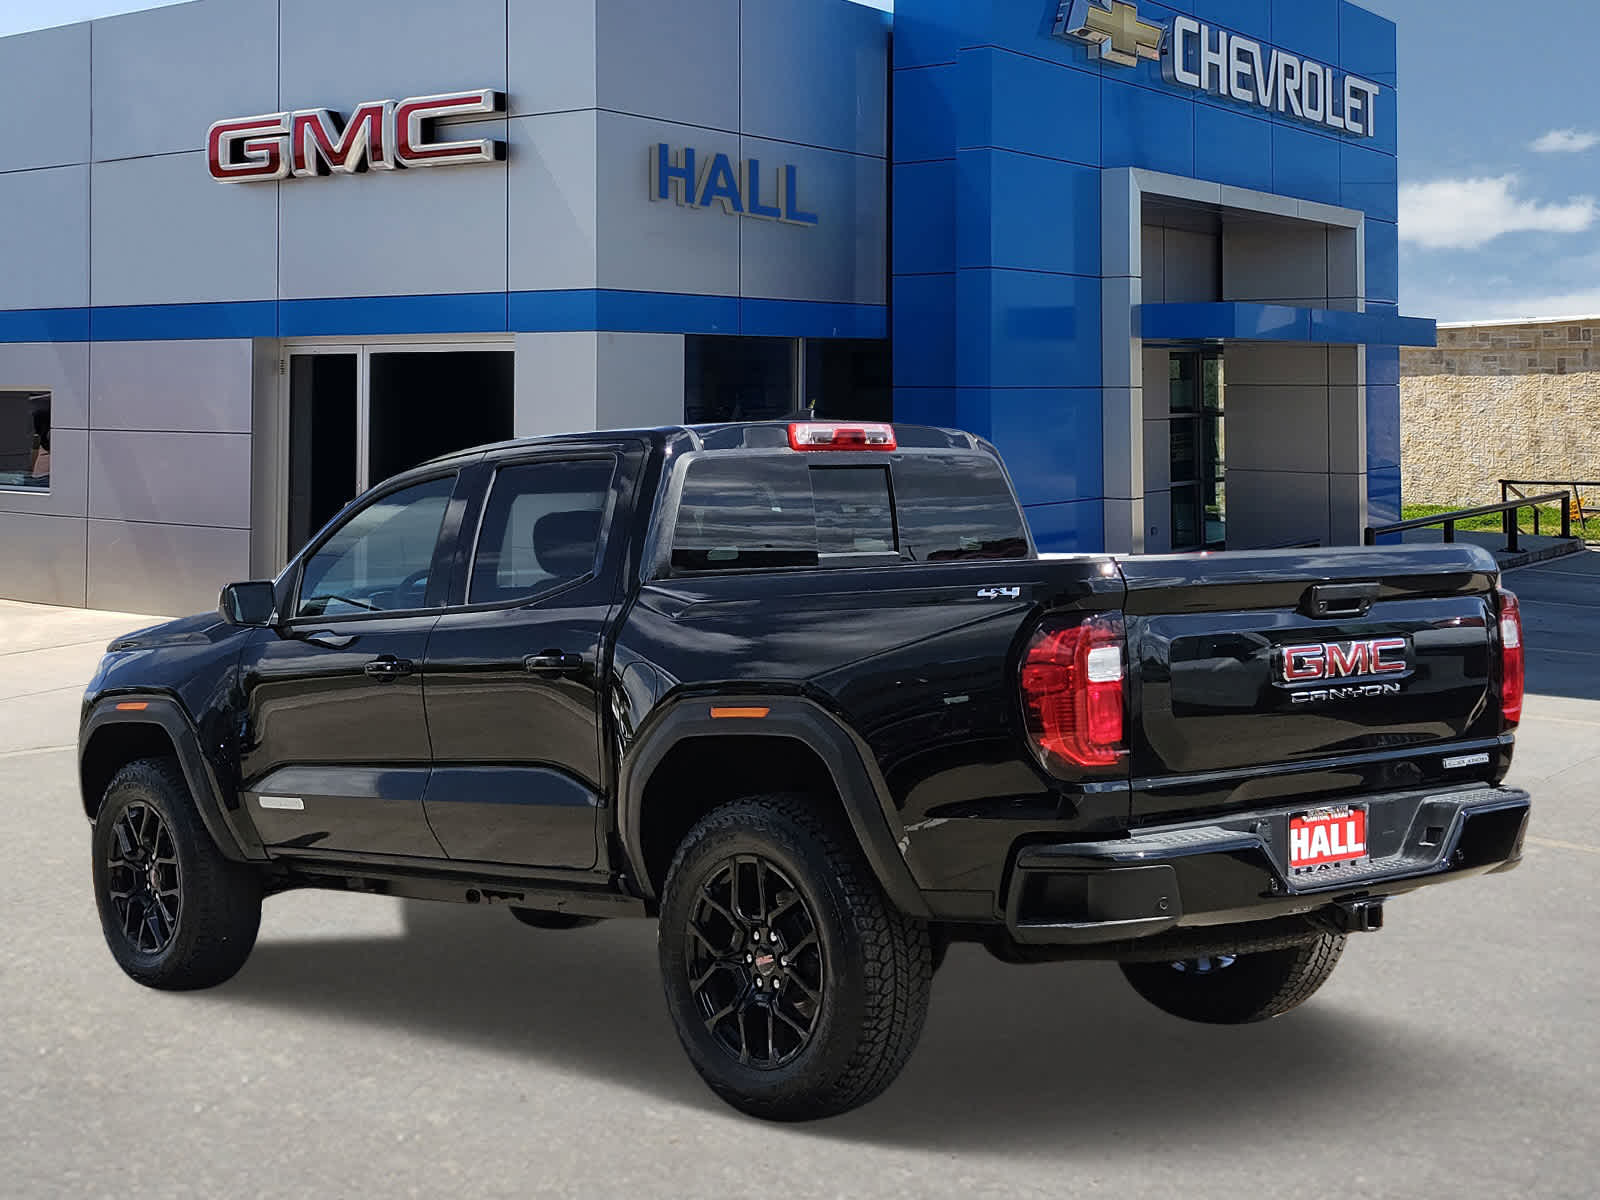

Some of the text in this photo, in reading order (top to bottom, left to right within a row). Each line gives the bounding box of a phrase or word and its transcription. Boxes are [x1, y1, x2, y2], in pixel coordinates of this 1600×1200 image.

[1173, 15, 1379, 137] CHEVROLET
[208, 88, 507, 184] GMC
[652, 142, 818, 227] HALL
[1282, 637, 1406, 682] GMC
[1291, 682, 1402, 704] CANYON
[1290, 821, 1364, 861] HALL
